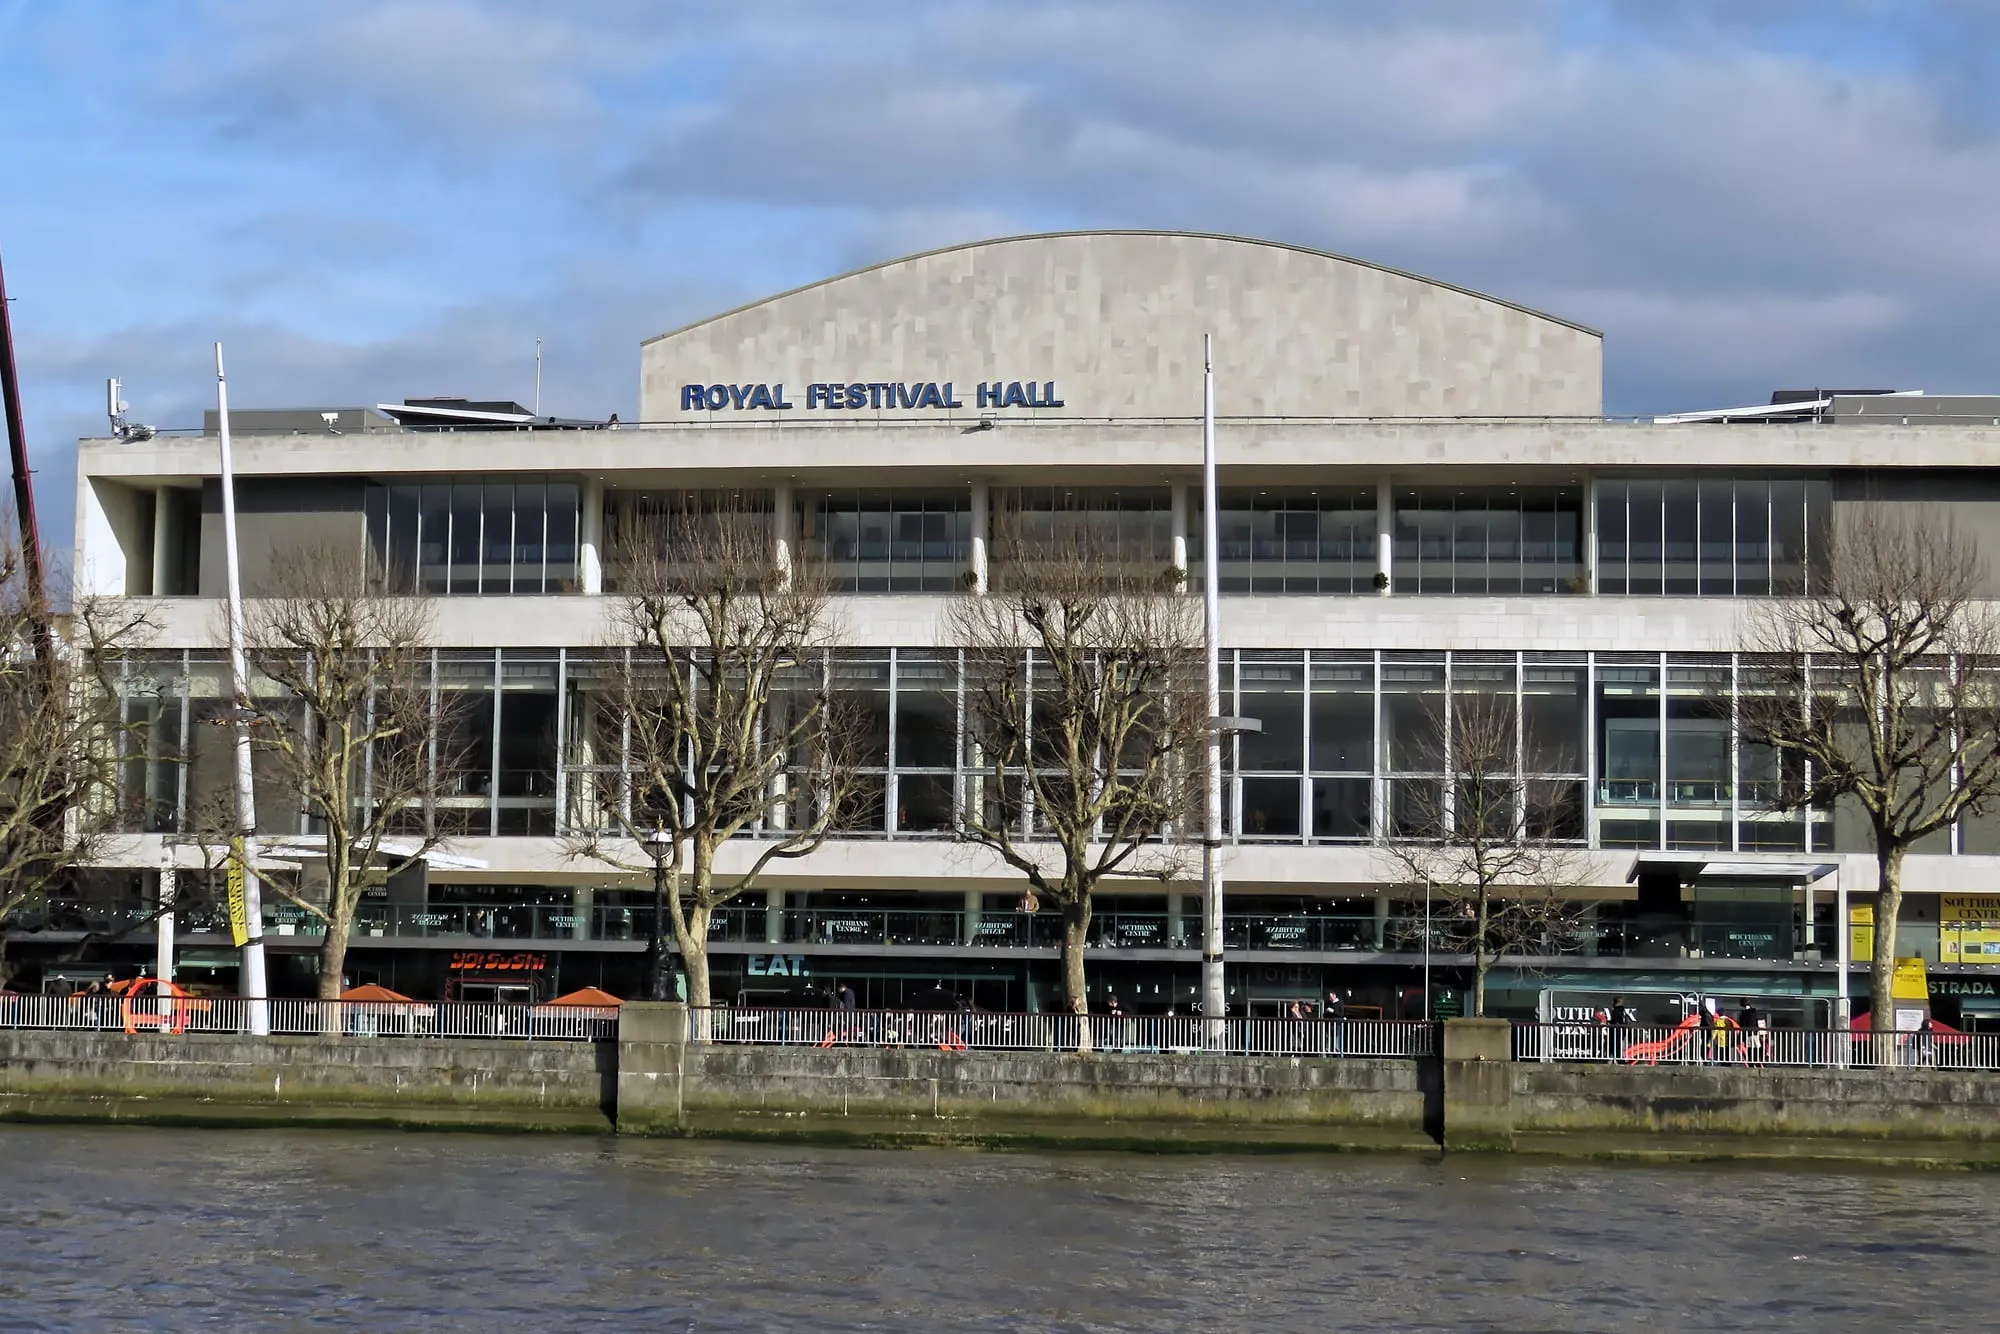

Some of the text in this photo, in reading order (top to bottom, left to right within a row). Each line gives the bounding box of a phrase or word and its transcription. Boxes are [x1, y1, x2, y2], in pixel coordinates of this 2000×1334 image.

[680, 381, 1065, 411] ROYAL FESTIVAL HALL
[748, 954, 810, 977] EAT.
[1928, 981, 1996, 995] STRADA
[1191, 1002, 1231, 1012] FOS
